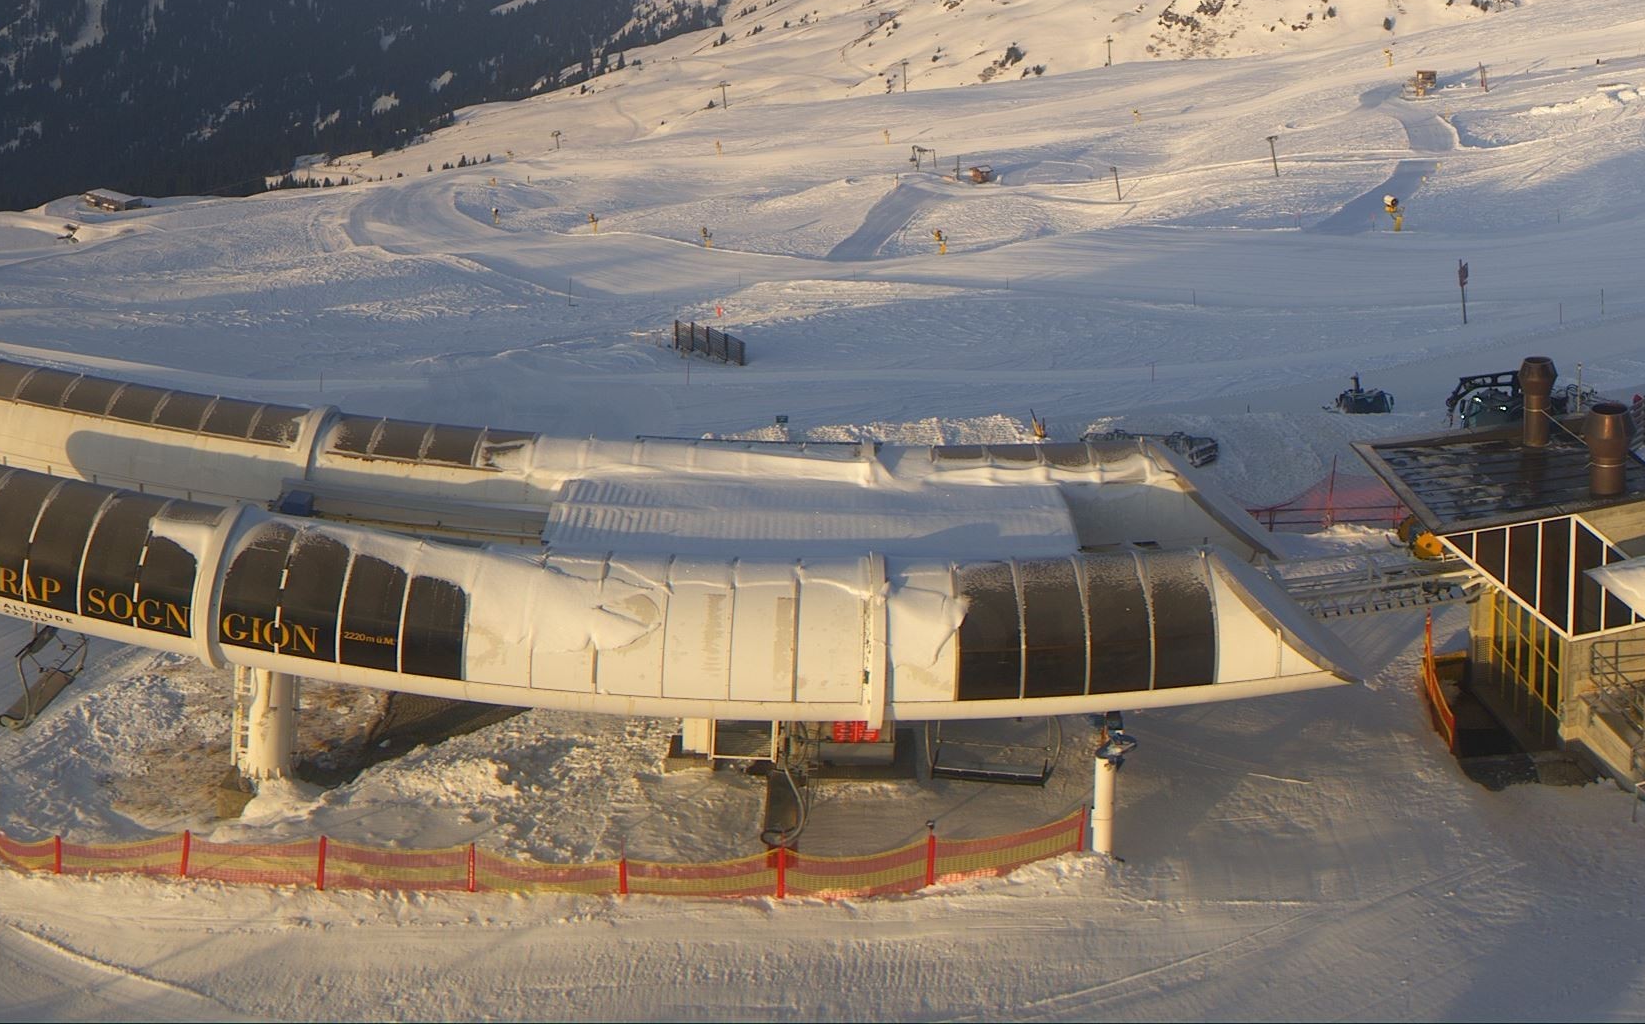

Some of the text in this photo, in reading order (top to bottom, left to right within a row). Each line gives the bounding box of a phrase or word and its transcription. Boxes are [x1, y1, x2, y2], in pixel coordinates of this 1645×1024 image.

[4, 603, 73, 624] ALTITUDE
[87, 588, 191, 632] SOGN
[222, 613, 319, 654] GION
